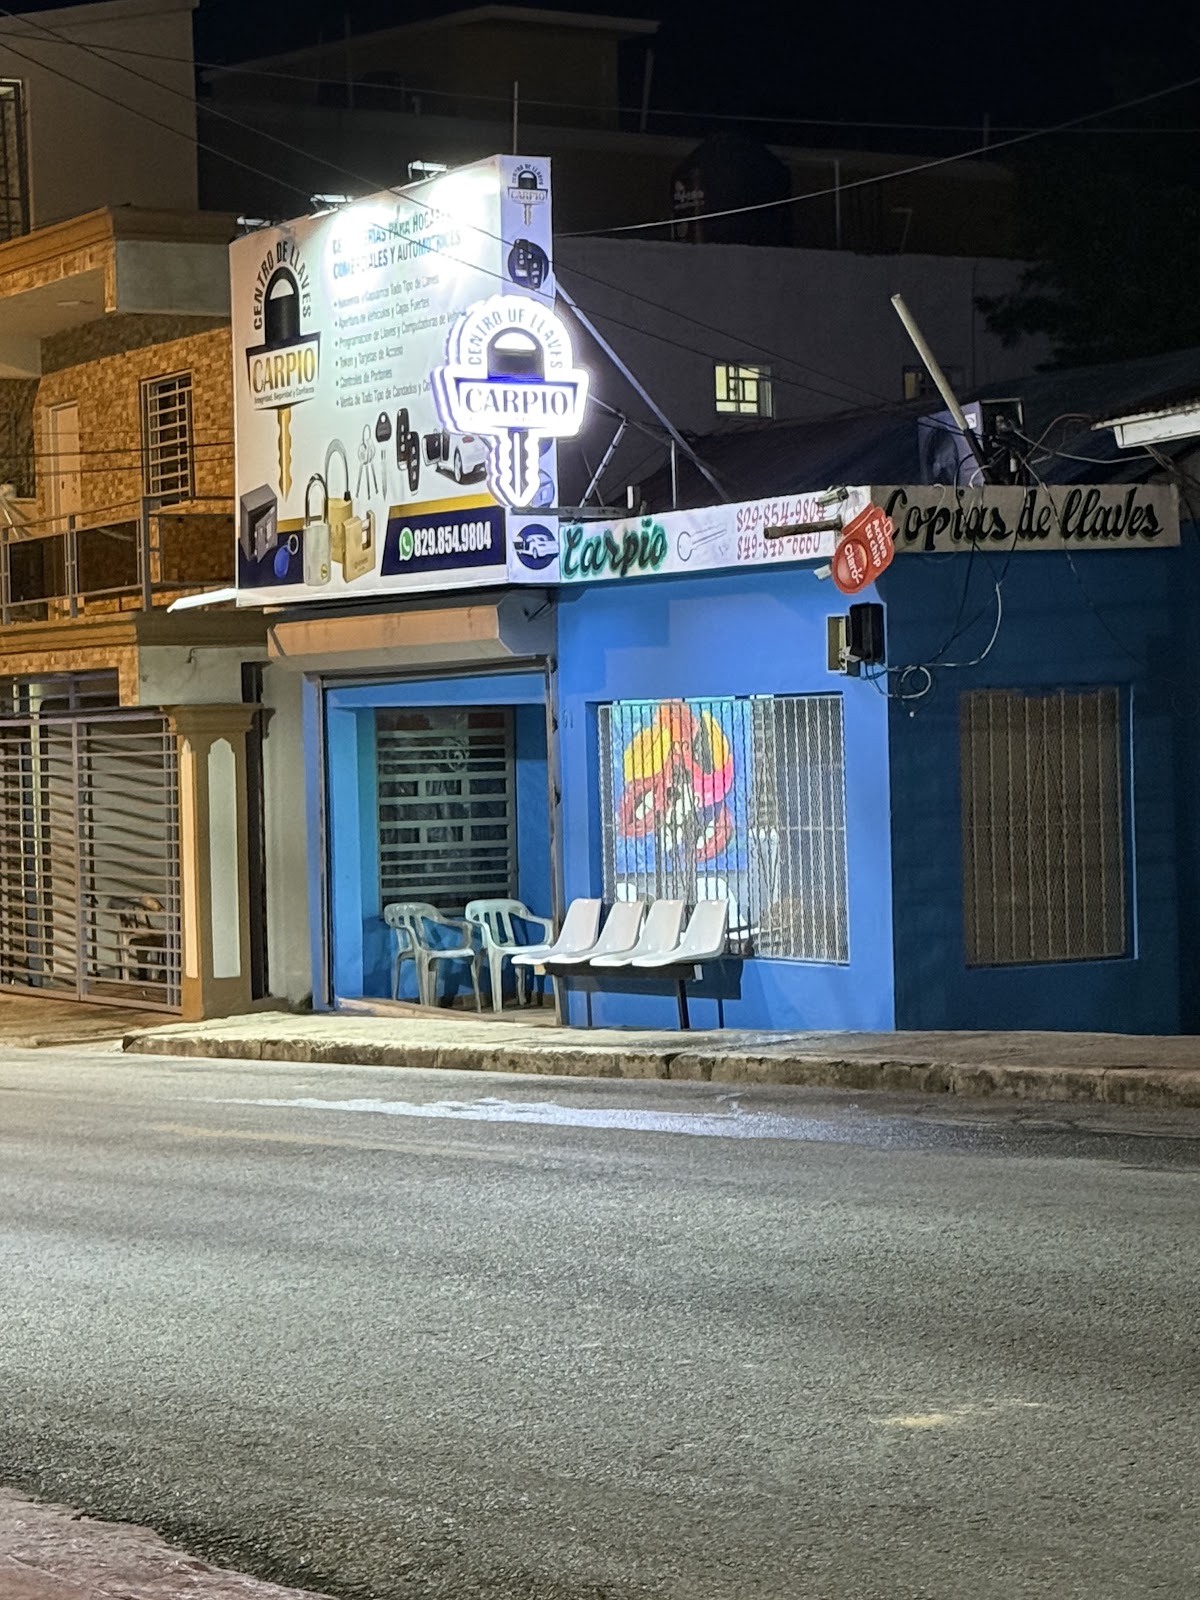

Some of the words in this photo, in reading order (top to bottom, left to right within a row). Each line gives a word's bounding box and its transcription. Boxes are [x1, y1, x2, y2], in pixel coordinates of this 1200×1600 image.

[390, 246, 396, 264] Y
[253, 249, 274, 331] CENTRO
[276, 241, 288, 263] DE
[290, 245, 311, 318] LLAVES
[468, 311, 502, 365] CENTRO
[529, 314, 563, 369] LLAVES
[253, 347, 315, 394] CARPIO
[465, 388, 568, 416] CARPIO
[414, 521, 492, 557] 829.854.9804
[872, 519, 887, 560] Activa
[886, 489, 1013, 551] Copias
[1018, 489, 1051, 540] de
[1060, 487, 1164, 541] llaves
[562, 517, 668, 579] Carpio
[844, 543, 861, 582] Claro
[865, 524, 873, 539] tu
[870, 540, 881, 568] chip
